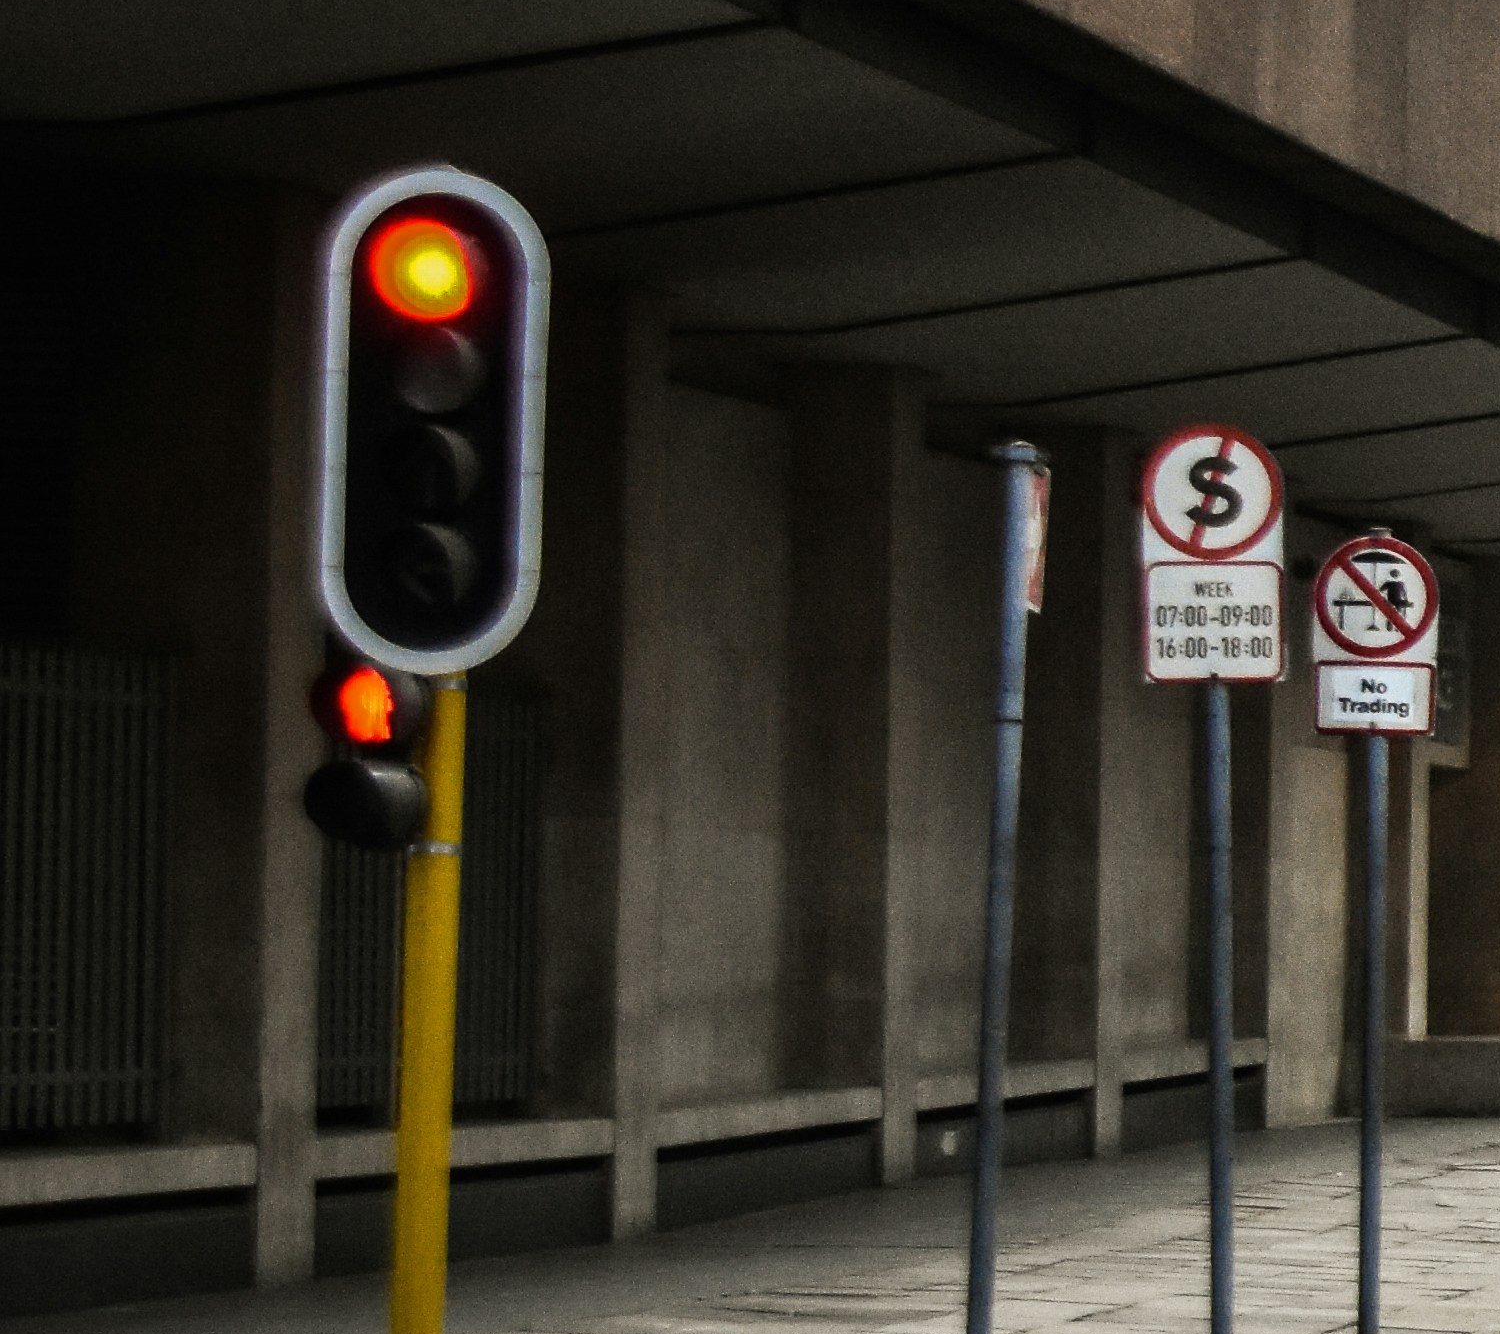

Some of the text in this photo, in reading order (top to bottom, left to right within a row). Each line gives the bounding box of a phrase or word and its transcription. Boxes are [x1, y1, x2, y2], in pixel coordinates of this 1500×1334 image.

[1195, 582, 1233, 598] WEEK
[1156, 605, 1273, 627] 07:00-09:00
[1156, 637, 1273, 658] 16:00-18:00
[1361, 679, 1387, 694] No
[1339, 697, 1410, 717] Trading
